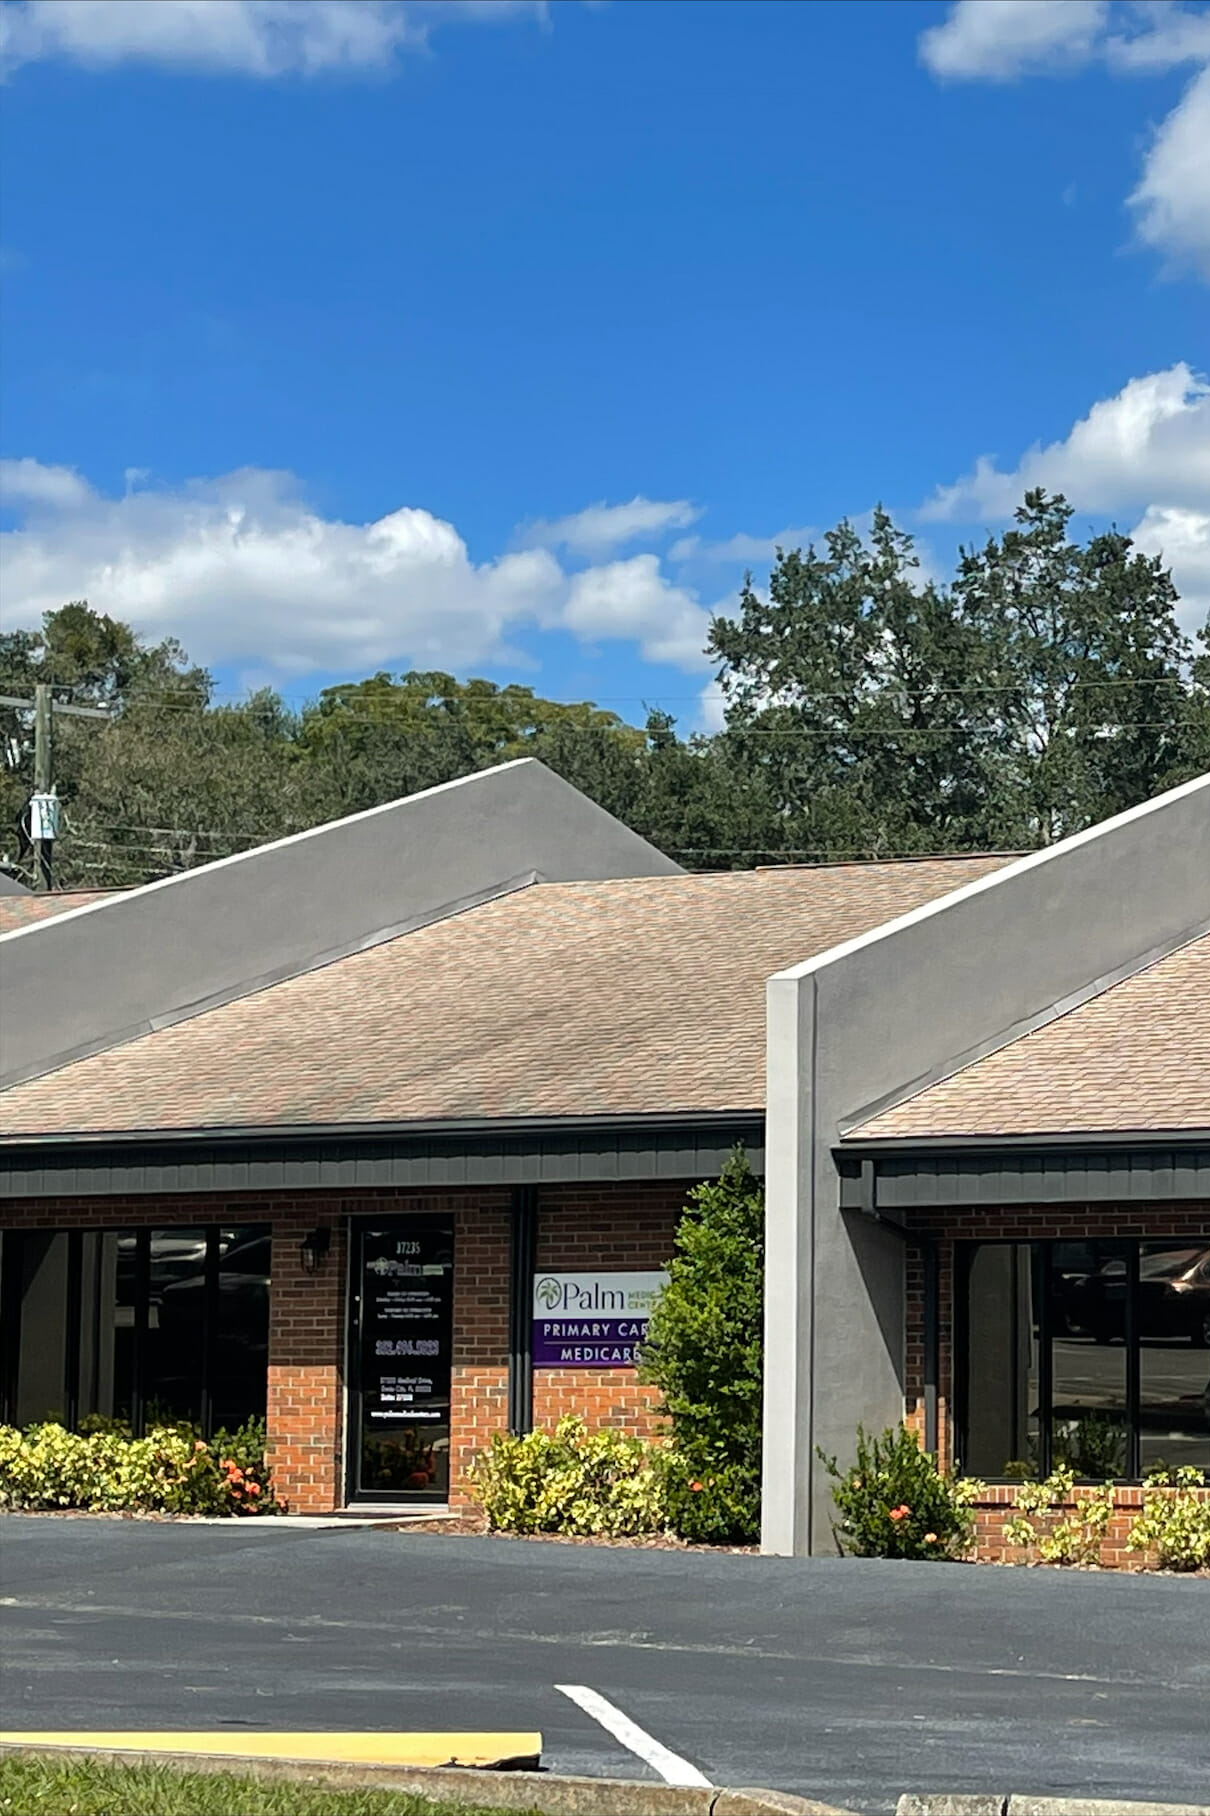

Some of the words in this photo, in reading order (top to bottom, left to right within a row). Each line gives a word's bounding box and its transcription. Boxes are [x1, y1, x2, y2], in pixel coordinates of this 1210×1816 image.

[563, 1282, 625, 1310] Palm
[543, 1323, 610, 1337] PRIMARY
[617, 1322, 649, 1337] CAR
